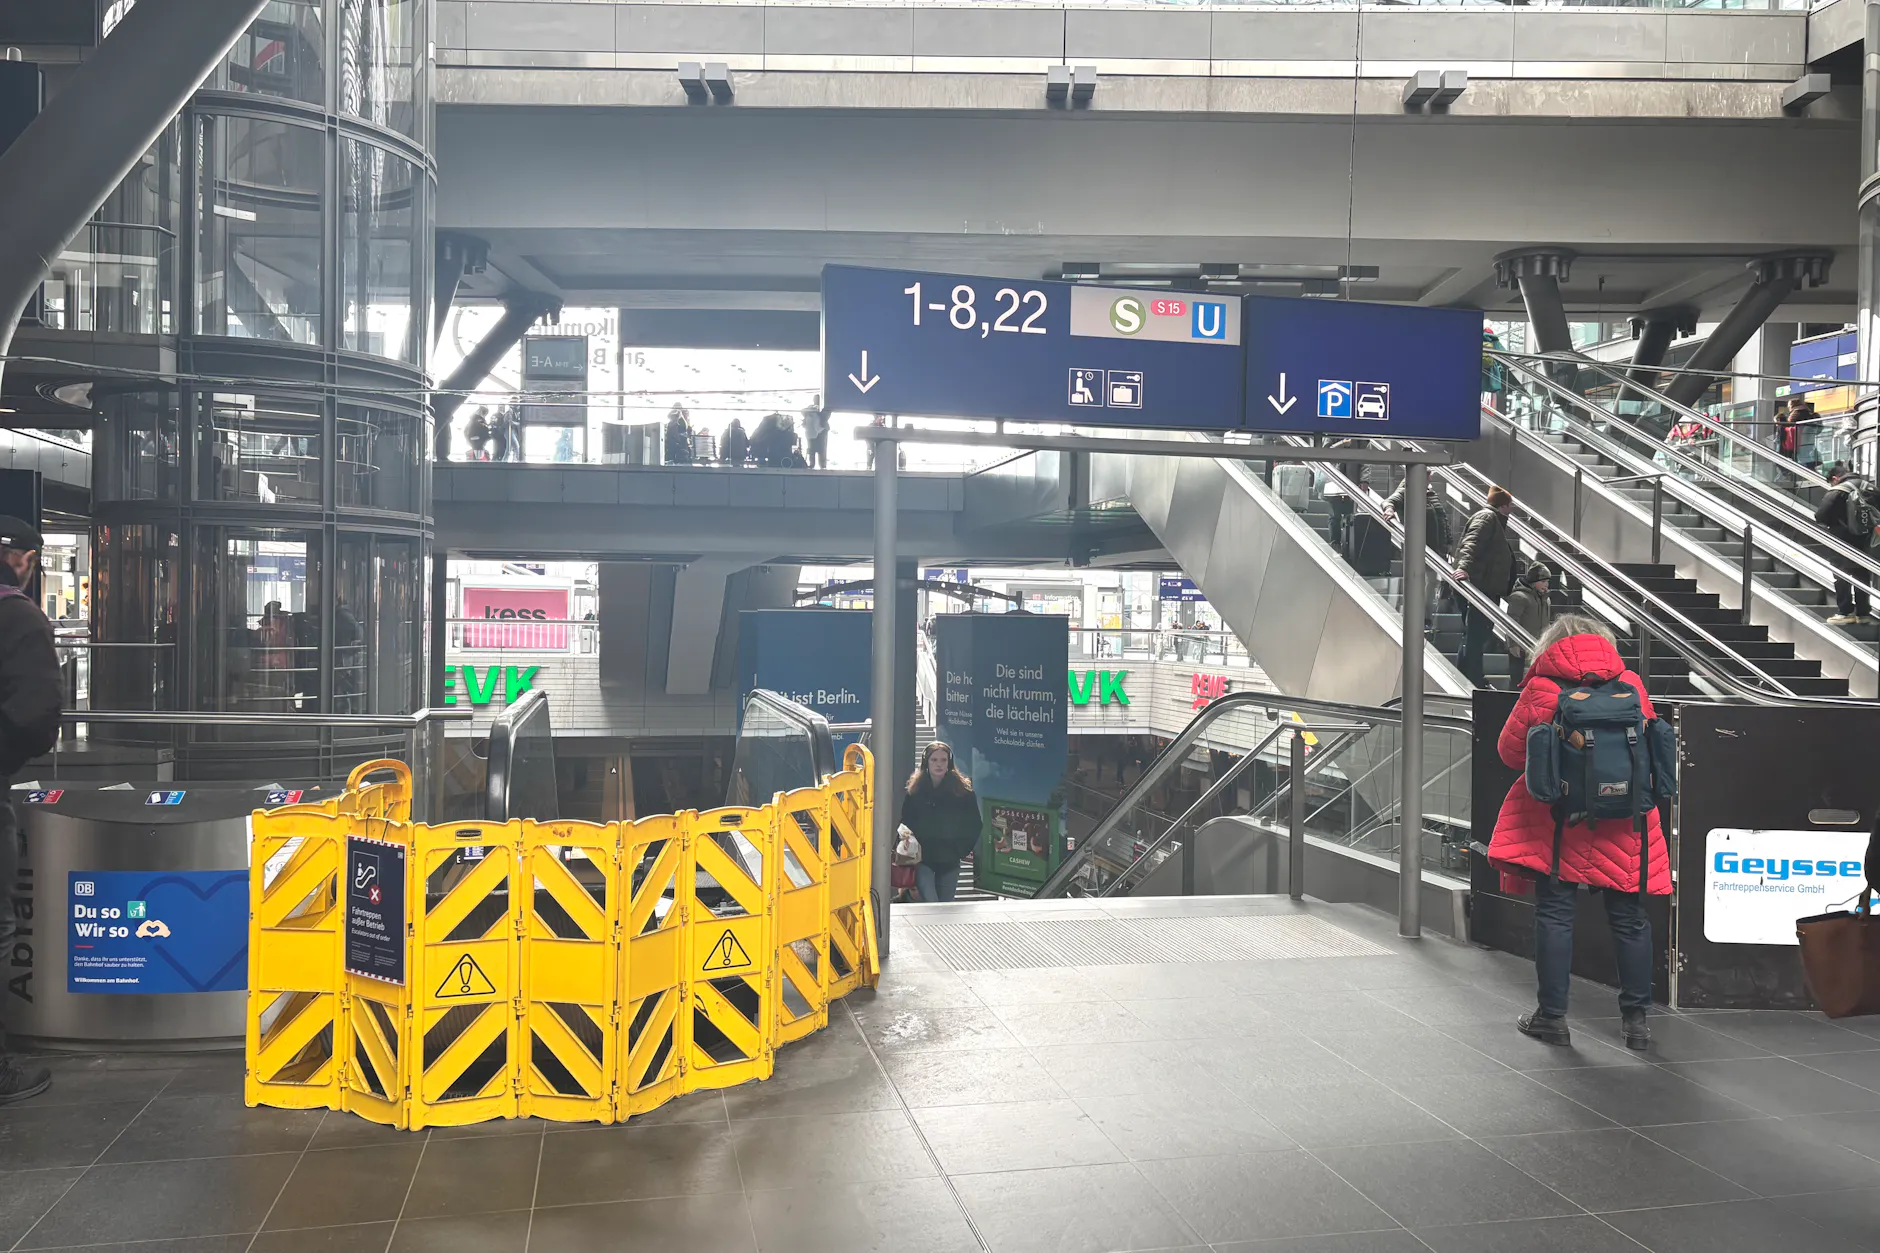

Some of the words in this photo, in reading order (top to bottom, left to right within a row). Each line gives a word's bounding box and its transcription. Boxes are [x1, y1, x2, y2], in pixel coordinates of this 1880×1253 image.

[904, 282, 1047, 339] 1-8,22
[1115, 298, 1140, 333] S
[1157, 301, 1165, 314] S
[1168, 302, 1180, 315] 15
[1197, 304, 1220, 337] U
[1327, 391, 1343, 416] P
[1044, 593, 1079, 601] Information
[946, 670, 961, 684] Die
[996, 663, 1016, 679] Die
[1018, 664, 1043, 680] sind
[445, 665, 541, 705] EVK
[1068, 669, 1131, 705] VK
[1191, 673, 1228, 698] REWE
[817, 688, 860, 705] Berlin.
[946, 687, 969, 703] bitter
[983, 682, 1010, 699] nicht
[1012, 683, 1057, 705] krumm,
[985, 702, 1004, 720] die
[1007, 704, 1054, 723] lächeln!
[948, 718, 973, 727] Halbbitter-S
[996, 728, 1009, 737] Weil
[1018, 730, 1024, 738] in
[993, 737, 1025, 747] Schokolade
[1026, 739, 1046, 749] dürfen.
[1009, 857, 1031, 866] CASHEW
[1714, 852, 1862, 881] Geysse
[76, 882, 93, 896] DB
[1712, 881, 1795, 894] Fahrtreppenservice
[1797, 884, 1825, 894] GmbH
[74, 904, 97, 919] Du
[100, 907, 121, 919] so
[351, 906, 382, 920] Fahrtreppen
[75, 923, 106, 938] Wir
[109, 926, 129, 938] so
[366, 919, 385, 931] Betrieb
